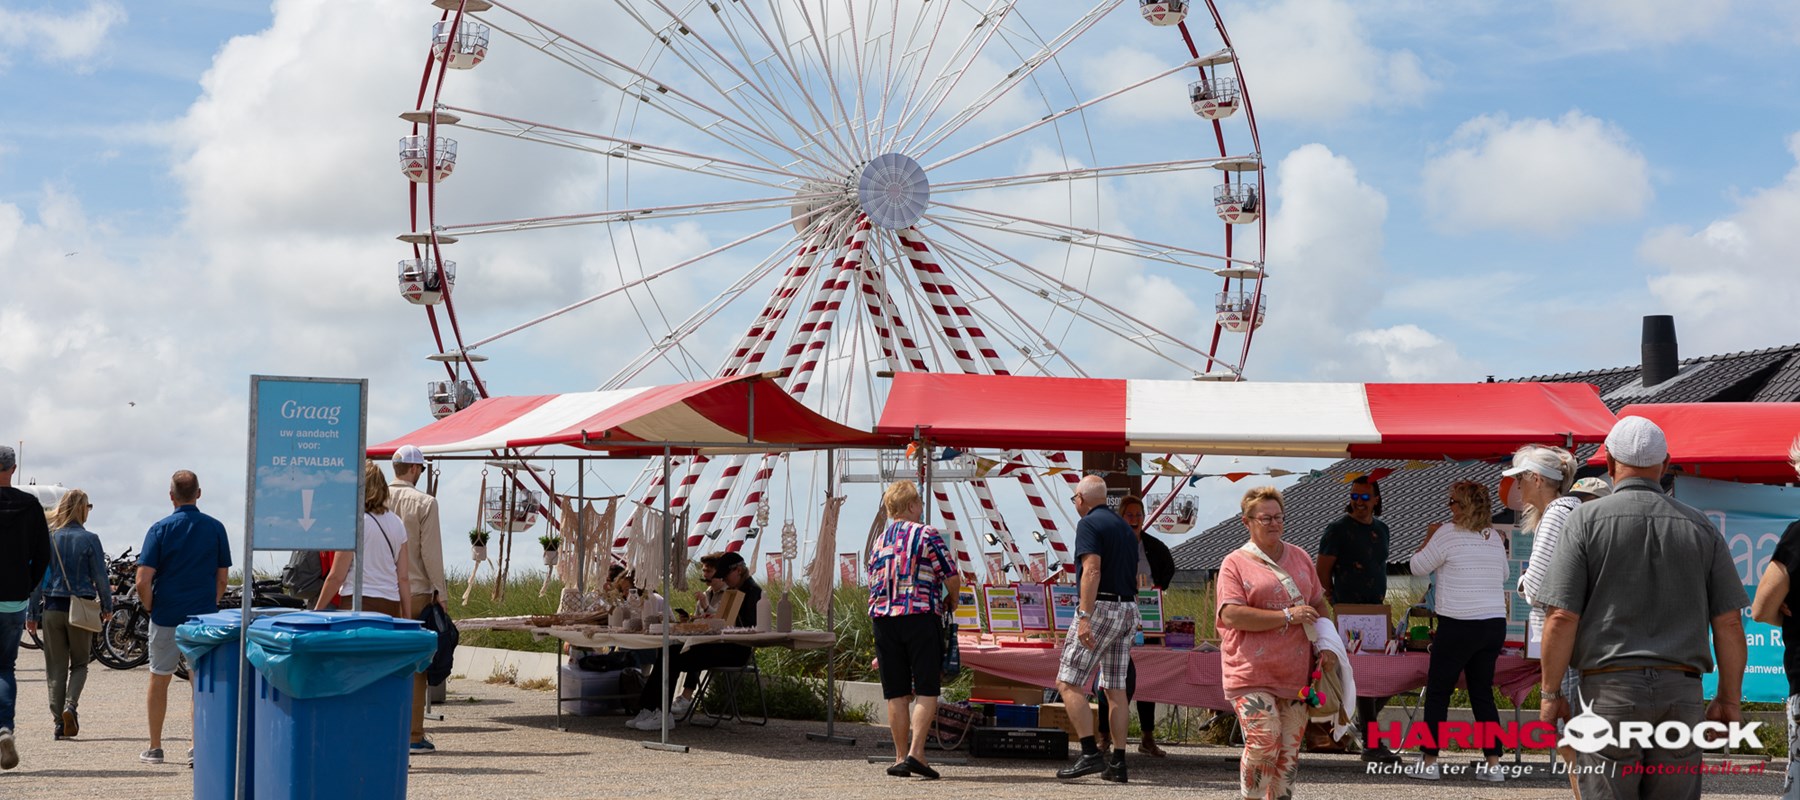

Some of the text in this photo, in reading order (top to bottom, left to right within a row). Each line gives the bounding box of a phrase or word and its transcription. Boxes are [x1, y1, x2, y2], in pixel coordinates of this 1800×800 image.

[281, 399, 341, 425] Graag
[296, 429, 339, 438] aandacht
[272, 456, 345, 467] DE AFVALBAK
[1745, 629, 1785, 646] an R
